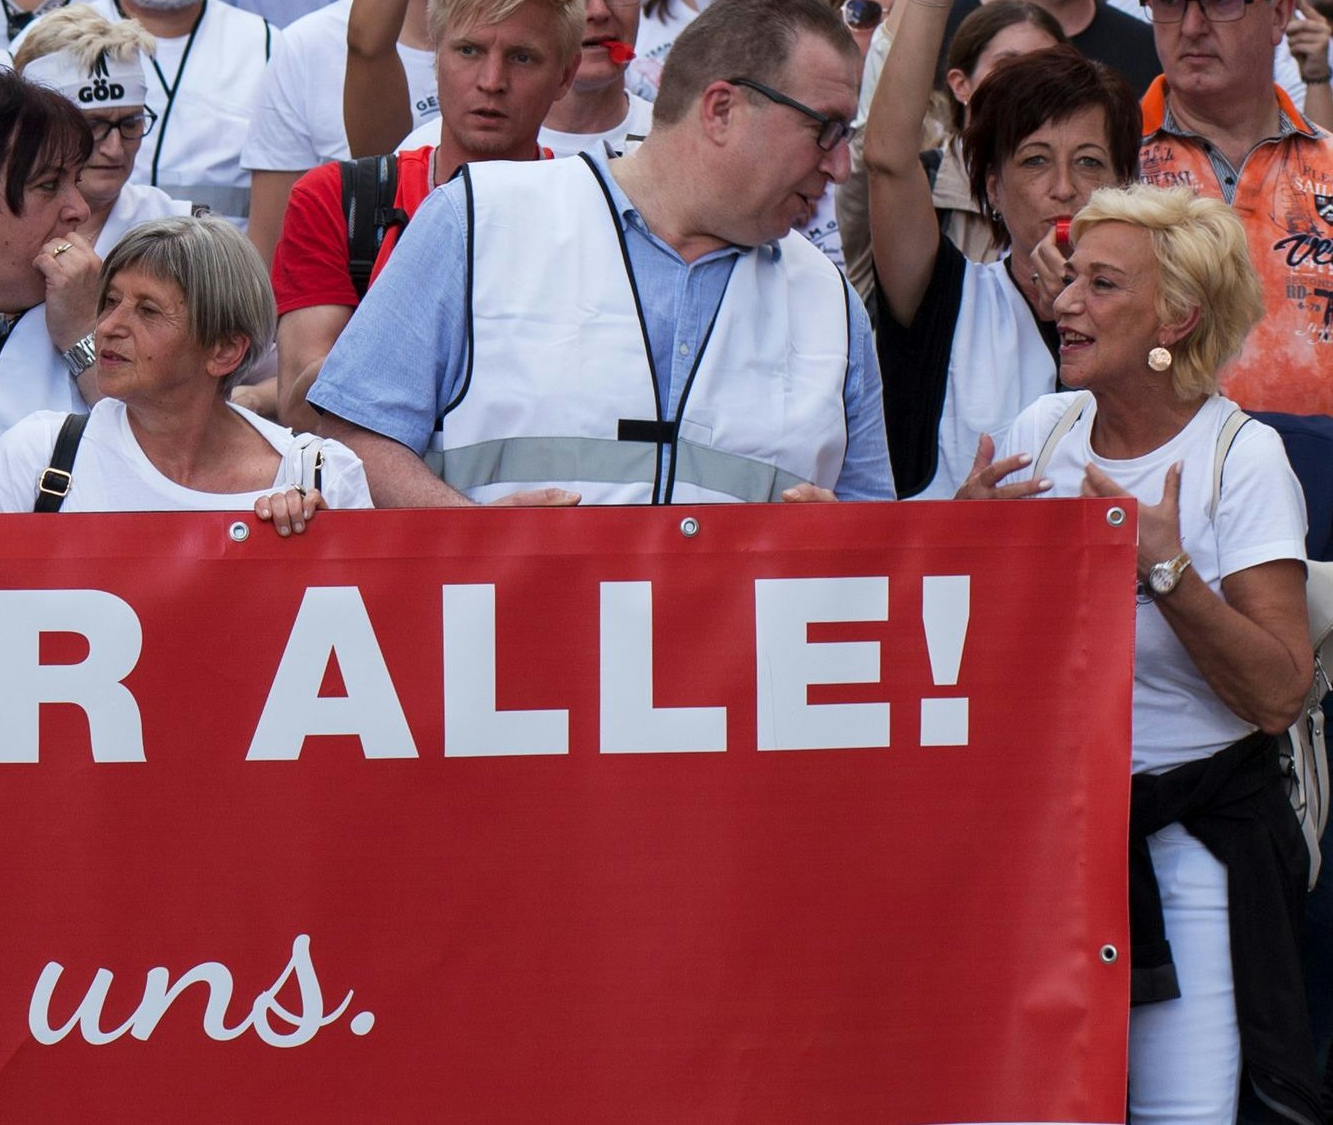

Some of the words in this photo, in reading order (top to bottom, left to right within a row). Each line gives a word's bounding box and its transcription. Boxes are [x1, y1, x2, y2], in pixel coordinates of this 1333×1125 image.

[77, 79, 125, 103] GÖD
[245, 575, 971, 761] ALLE!
[28, 934, 379, 1049] uns.
